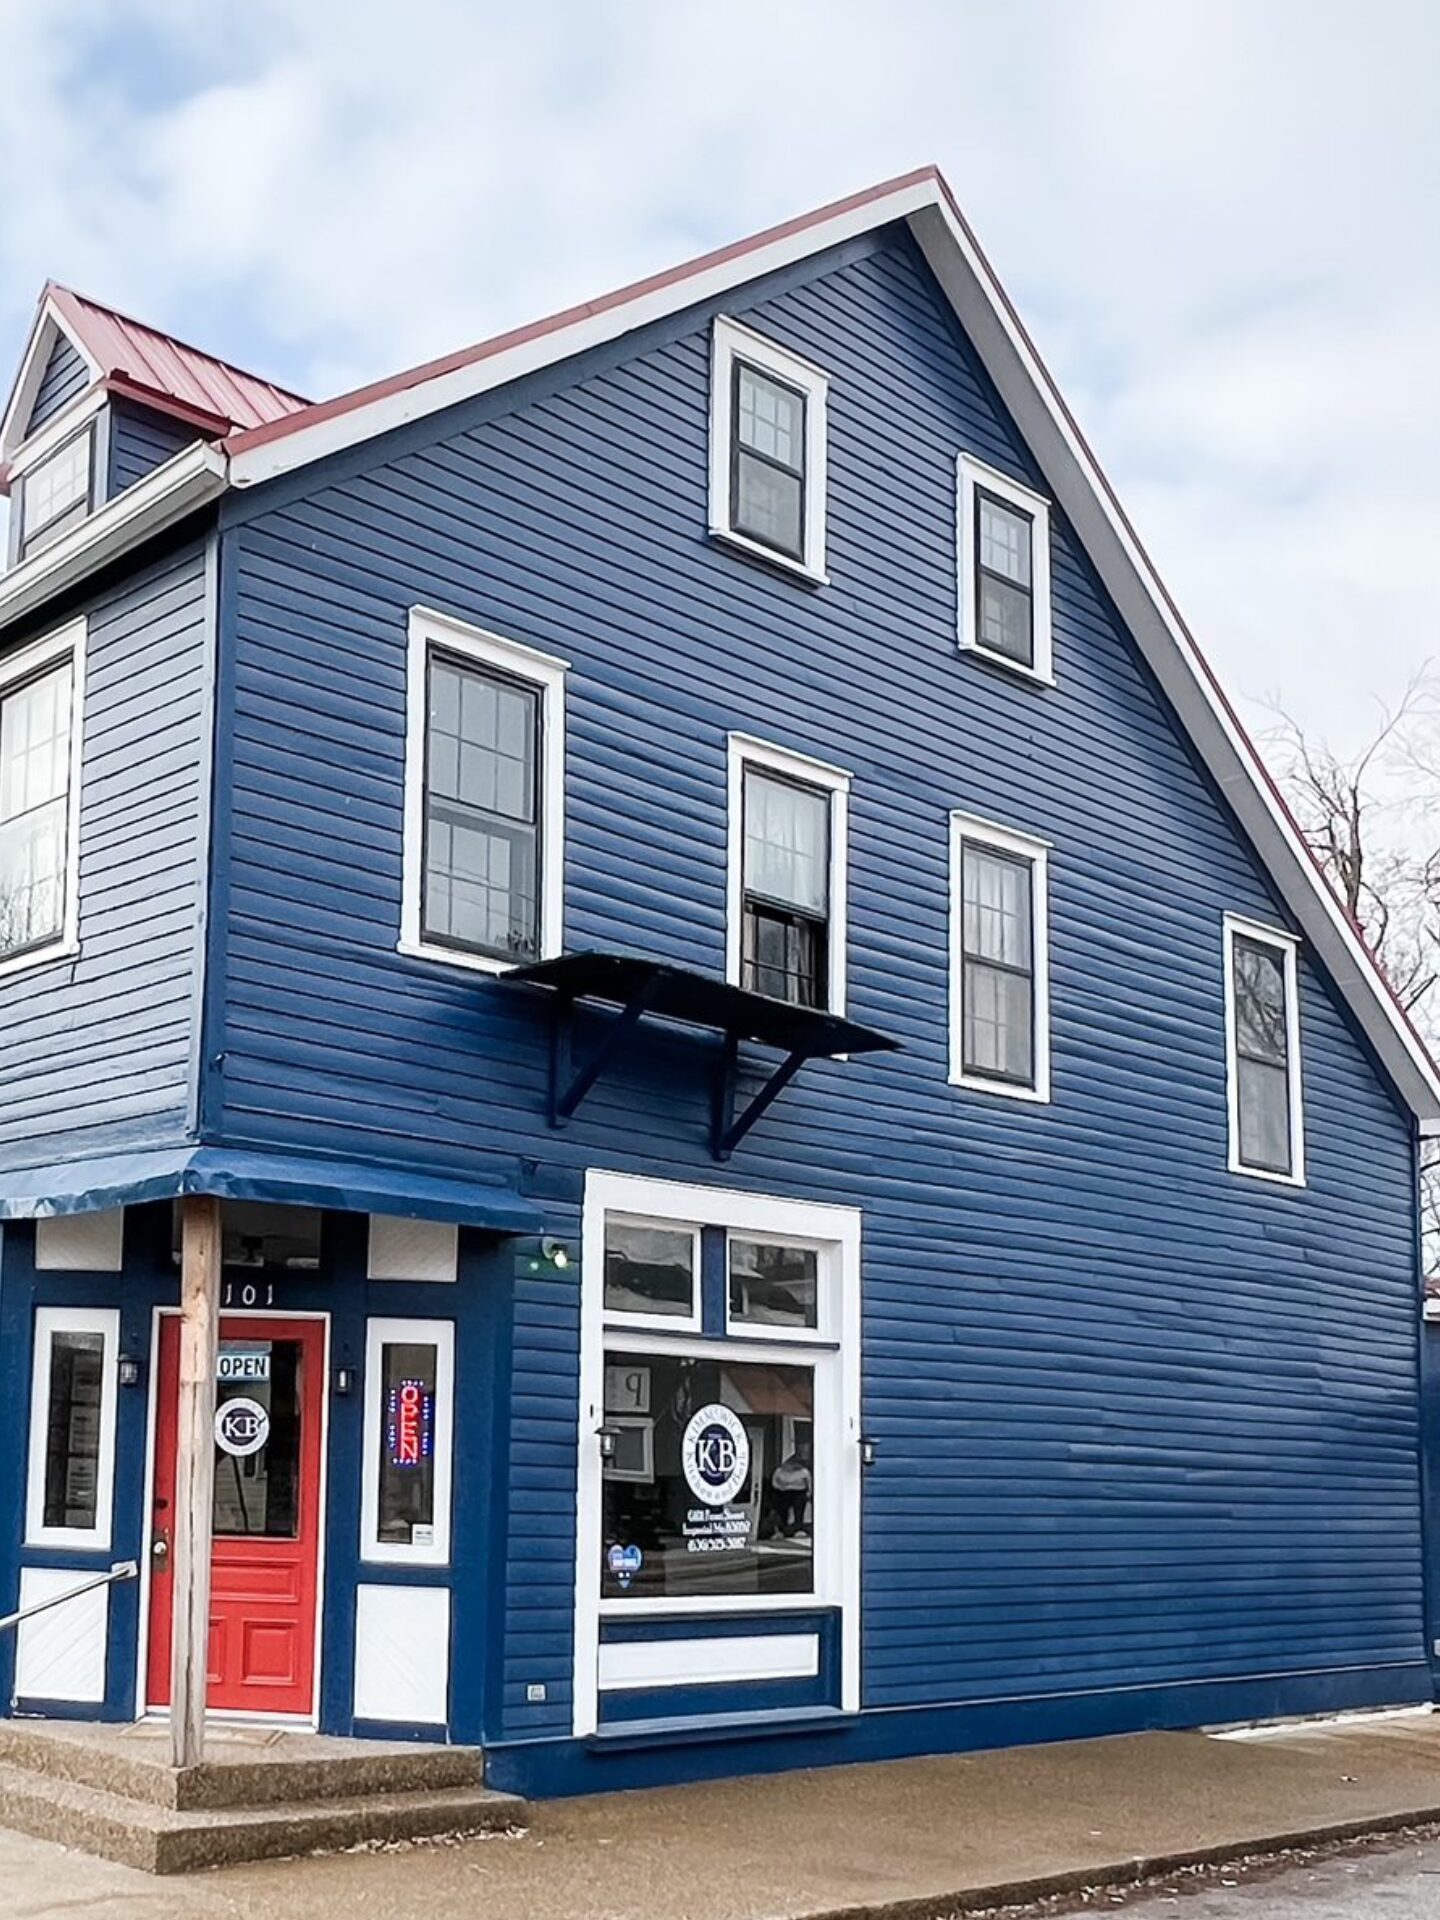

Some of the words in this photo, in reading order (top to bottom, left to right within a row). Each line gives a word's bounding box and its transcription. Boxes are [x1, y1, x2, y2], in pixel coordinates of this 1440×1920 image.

[225, 1283, 273, 1305] 101
[220, 1357, 266, 1376] OPEN
[225, 1416, 260, 1437] KB
[400, 1385, 419, 1460] OPEN
[698, 1439, 736, 1472] KB
